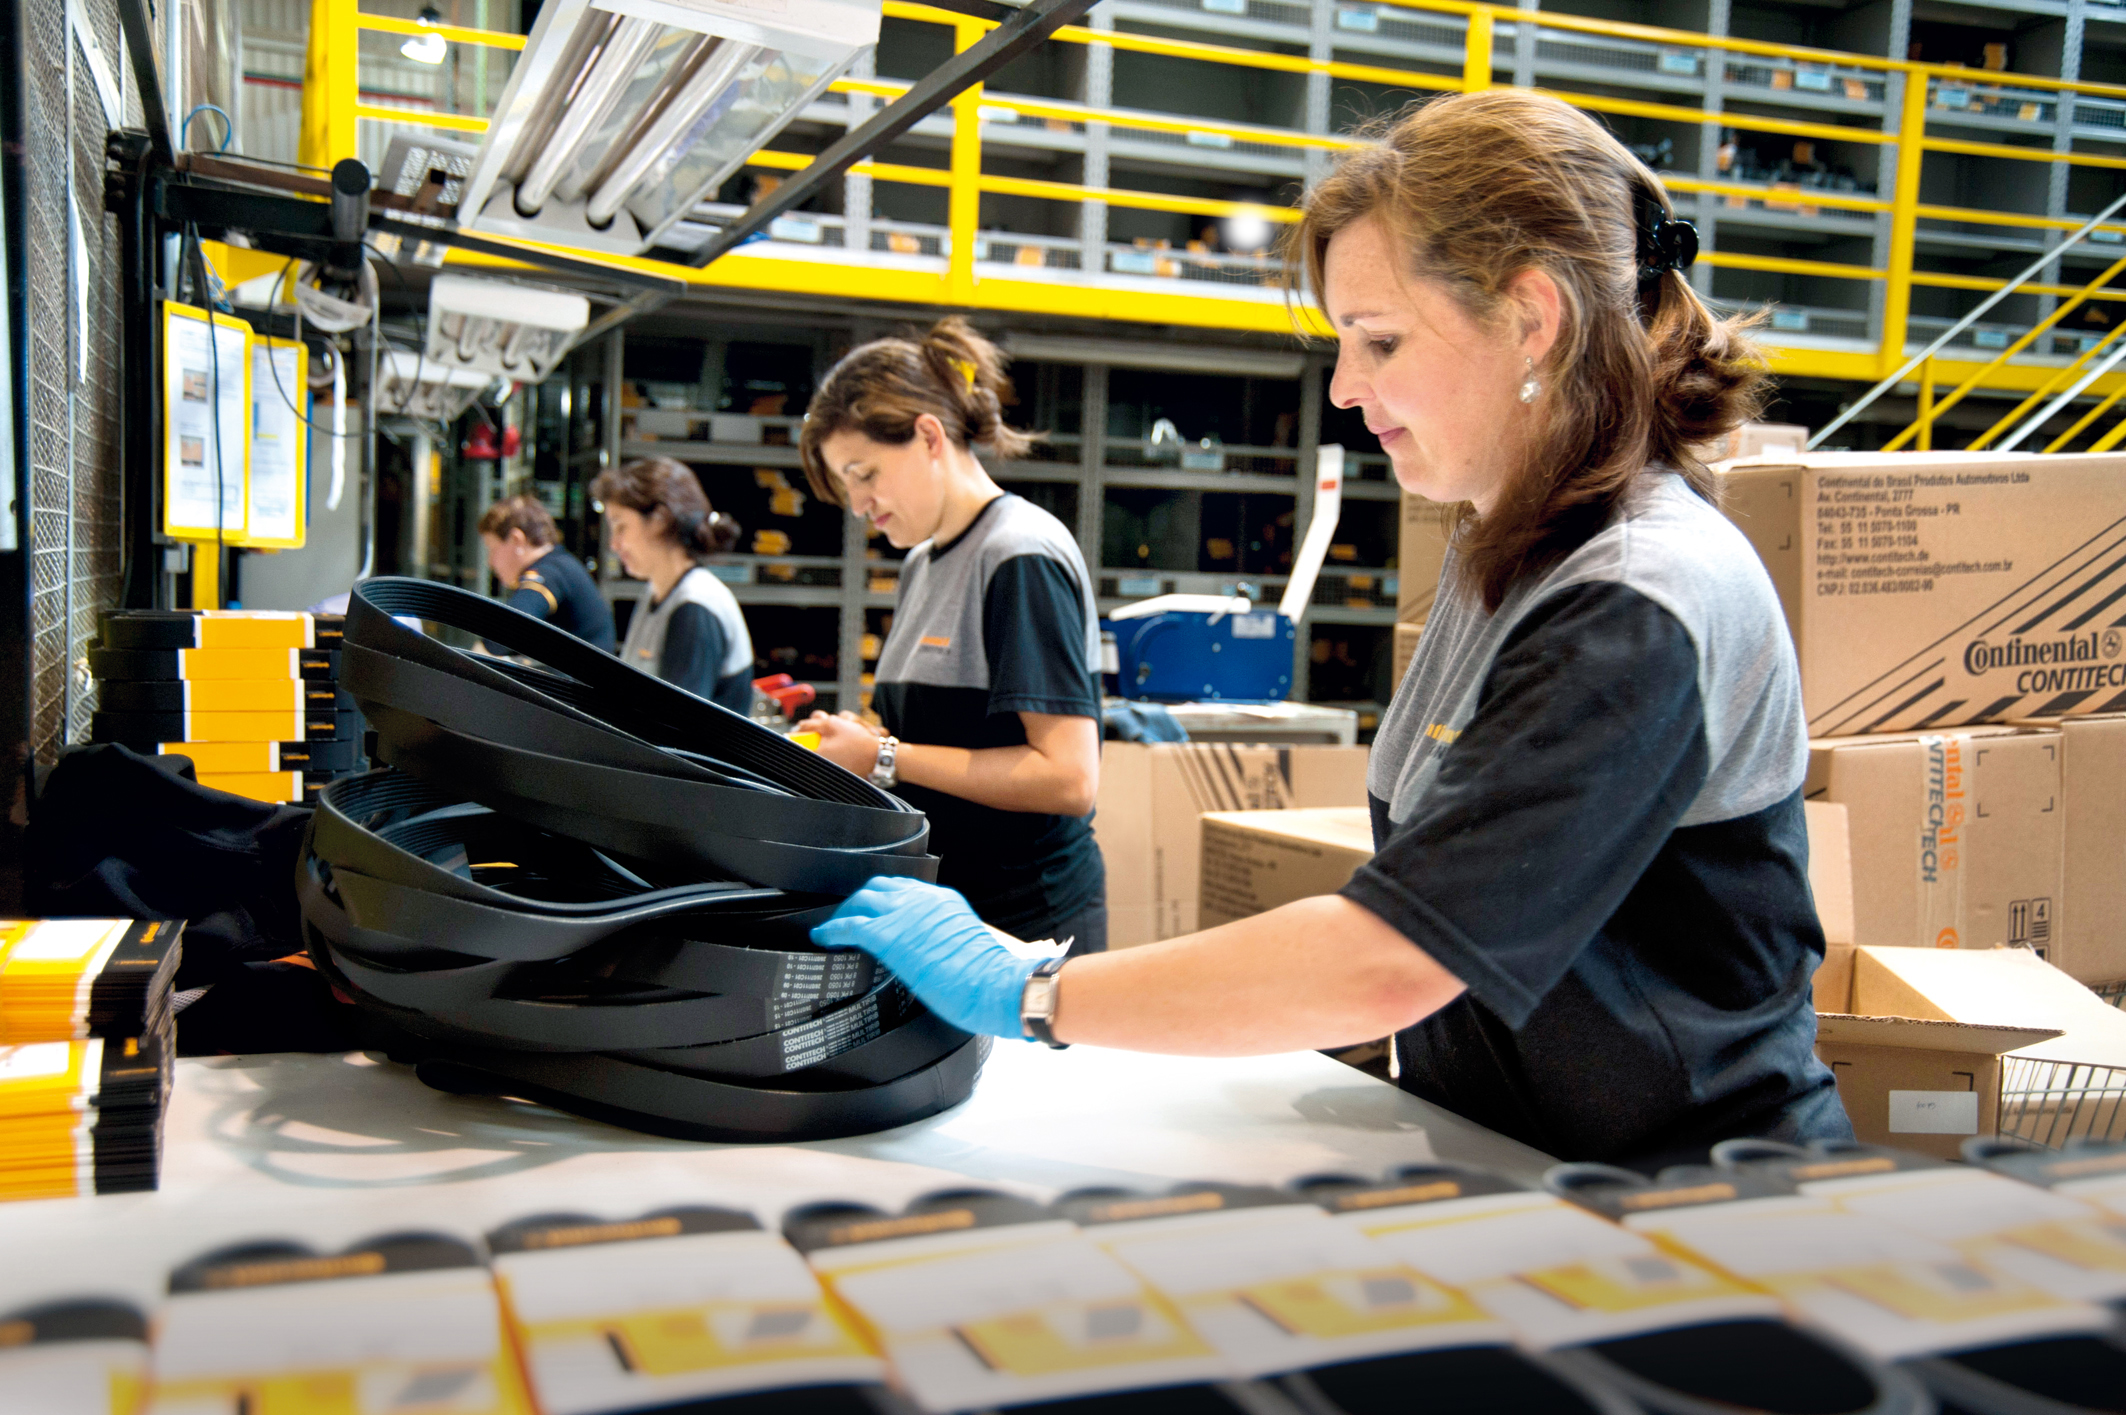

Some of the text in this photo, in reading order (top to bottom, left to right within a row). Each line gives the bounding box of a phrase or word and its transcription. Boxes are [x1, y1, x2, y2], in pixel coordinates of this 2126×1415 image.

[1818, 472, 2030, 488] Continental do Brasil Produtos Automotivos Ltda
[1834, 490, 1890, 503] Continental,
[1874, 505, 1902, 518] Ponta
[1904, 504, 1938, 517] Grossa
[1946, 502, 1960, 516] PR
[1964, 632, 2099, 676] Continental
[782, 1019, 823, 1037] CONTITECH
[783, 1028, 824, 1047] CONTITECH
[784, 1036, 825, 1053] CONTITECH
[785, 1046, 826, 1064] CONTITECH
[786, 1053, 827, 1070] CONTITECH
